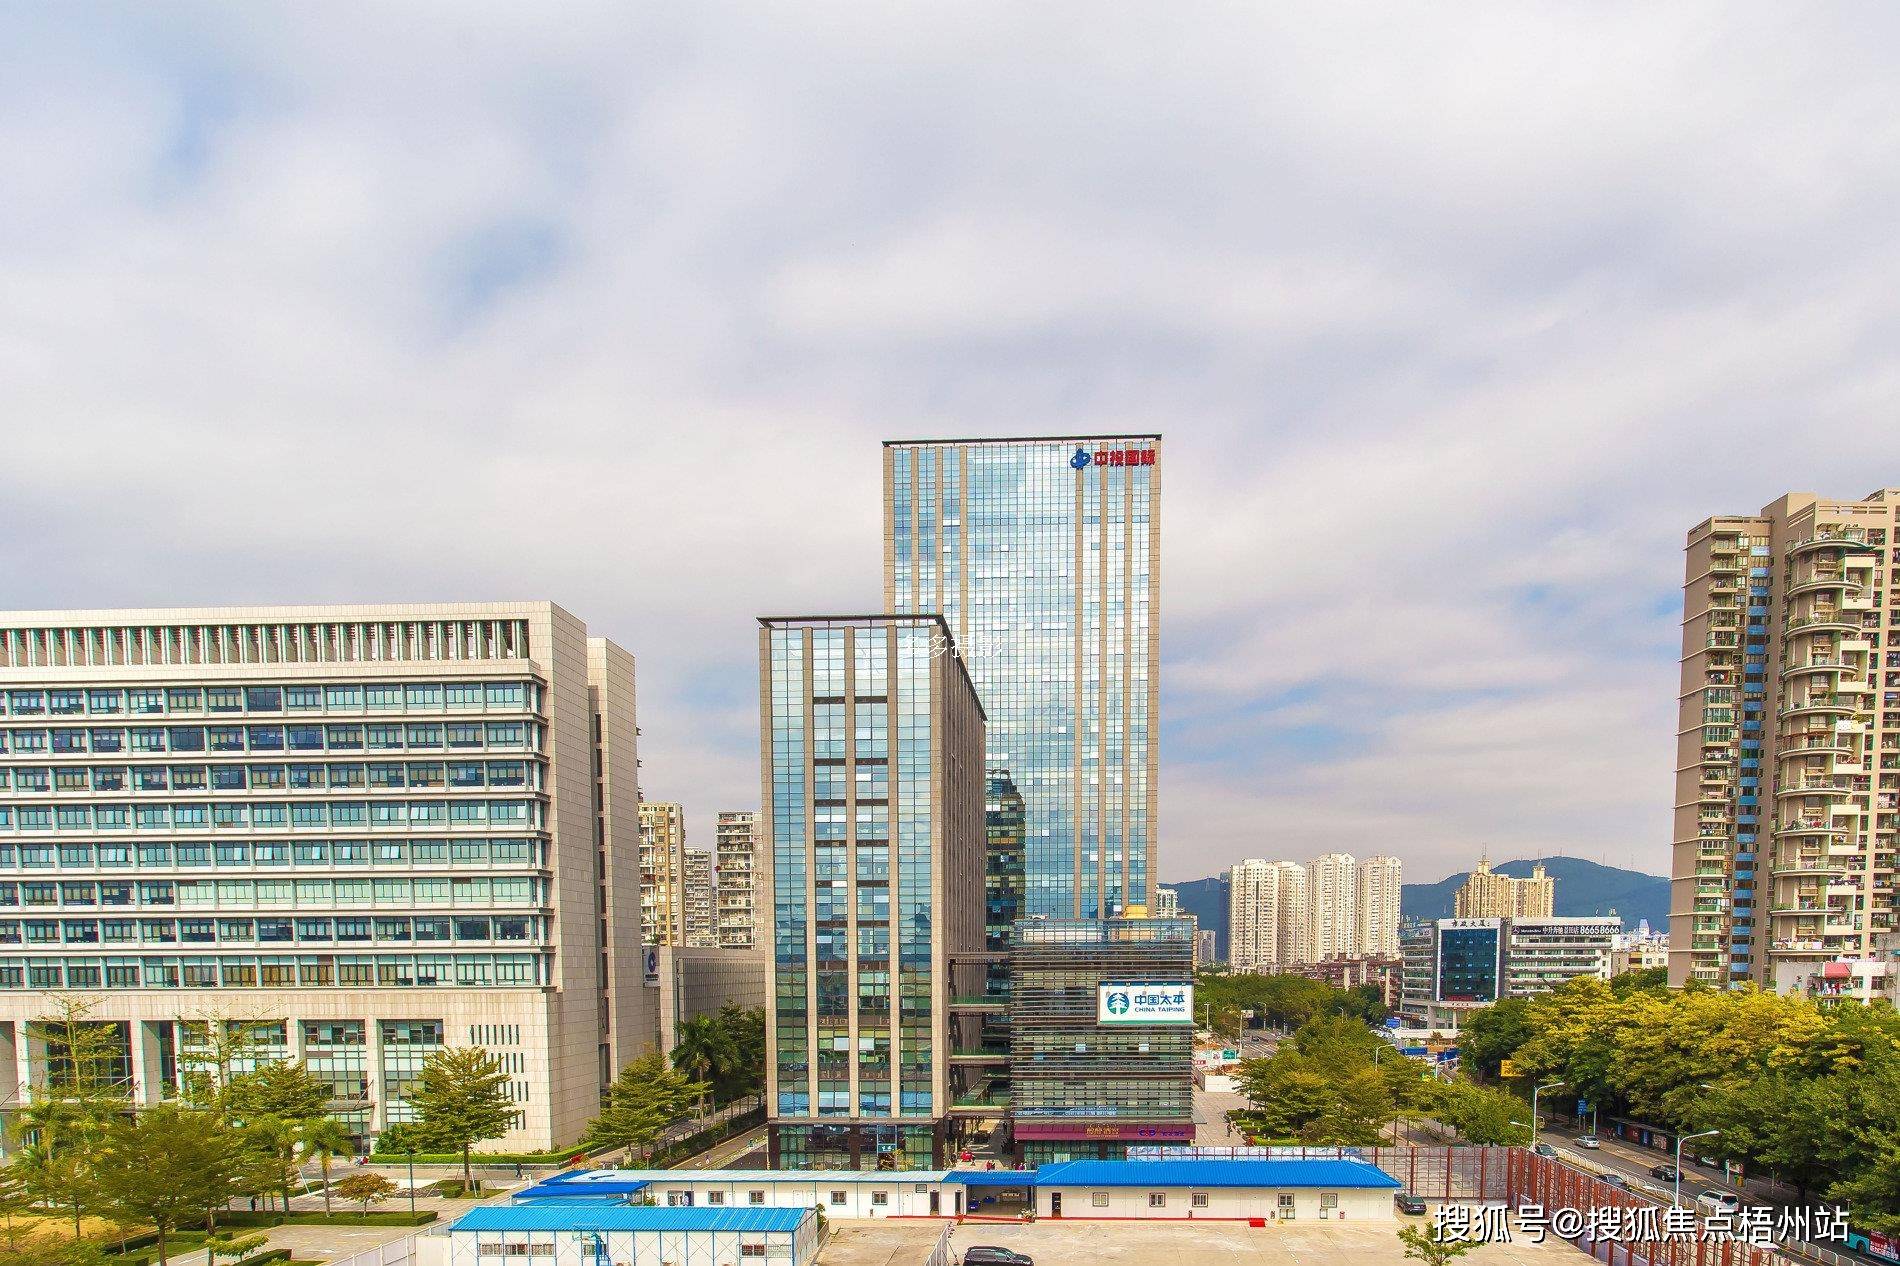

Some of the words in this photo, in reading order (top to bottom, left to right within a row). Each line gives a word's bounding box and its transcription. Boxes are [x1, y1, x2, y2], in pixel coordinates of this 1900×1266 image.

[1580, 925, 1620, 935] 86658666
[1134, 994, 1185, 1006] 中国太平
